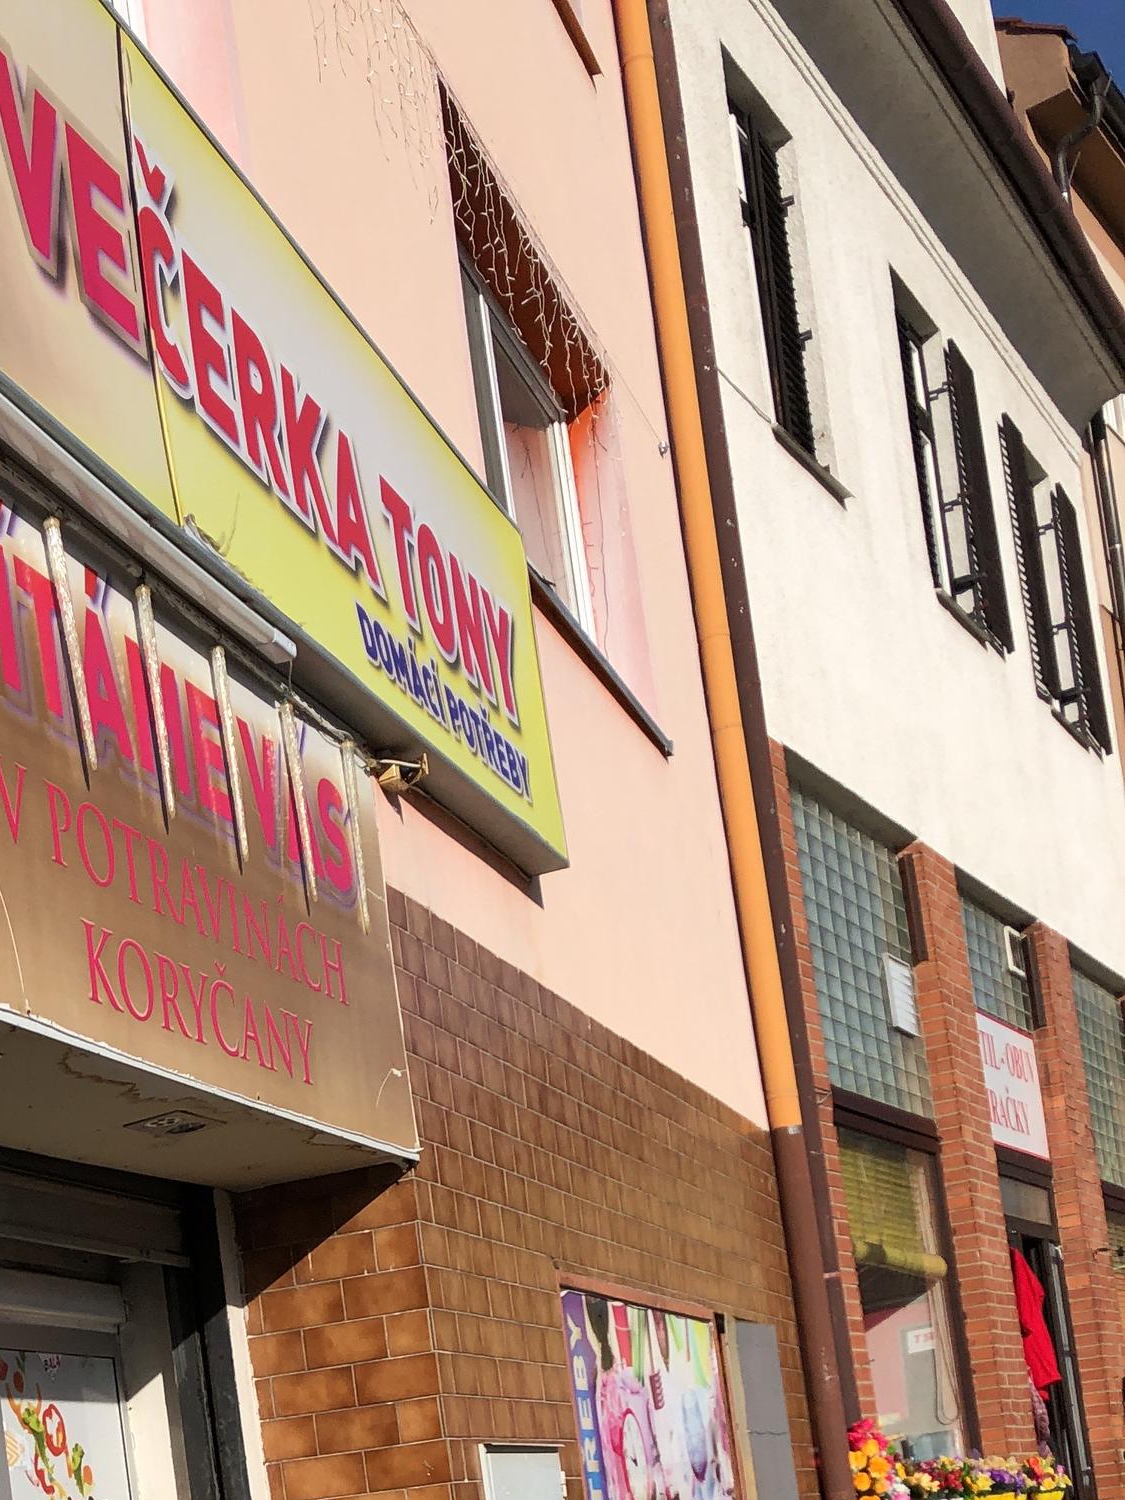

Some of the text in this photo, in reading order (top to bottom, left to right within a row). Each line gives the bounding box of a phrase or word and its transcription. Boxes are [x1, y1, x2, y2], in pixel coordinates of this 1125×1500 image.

[355, 601, 532, 801] DOMÁCÍ POTŘEBY
[379, 474, 518, 720] TONY
[43, 778, 351, 1006] POTRAVINÁCH
[79, 917, 316, 1085] KORYČANY
